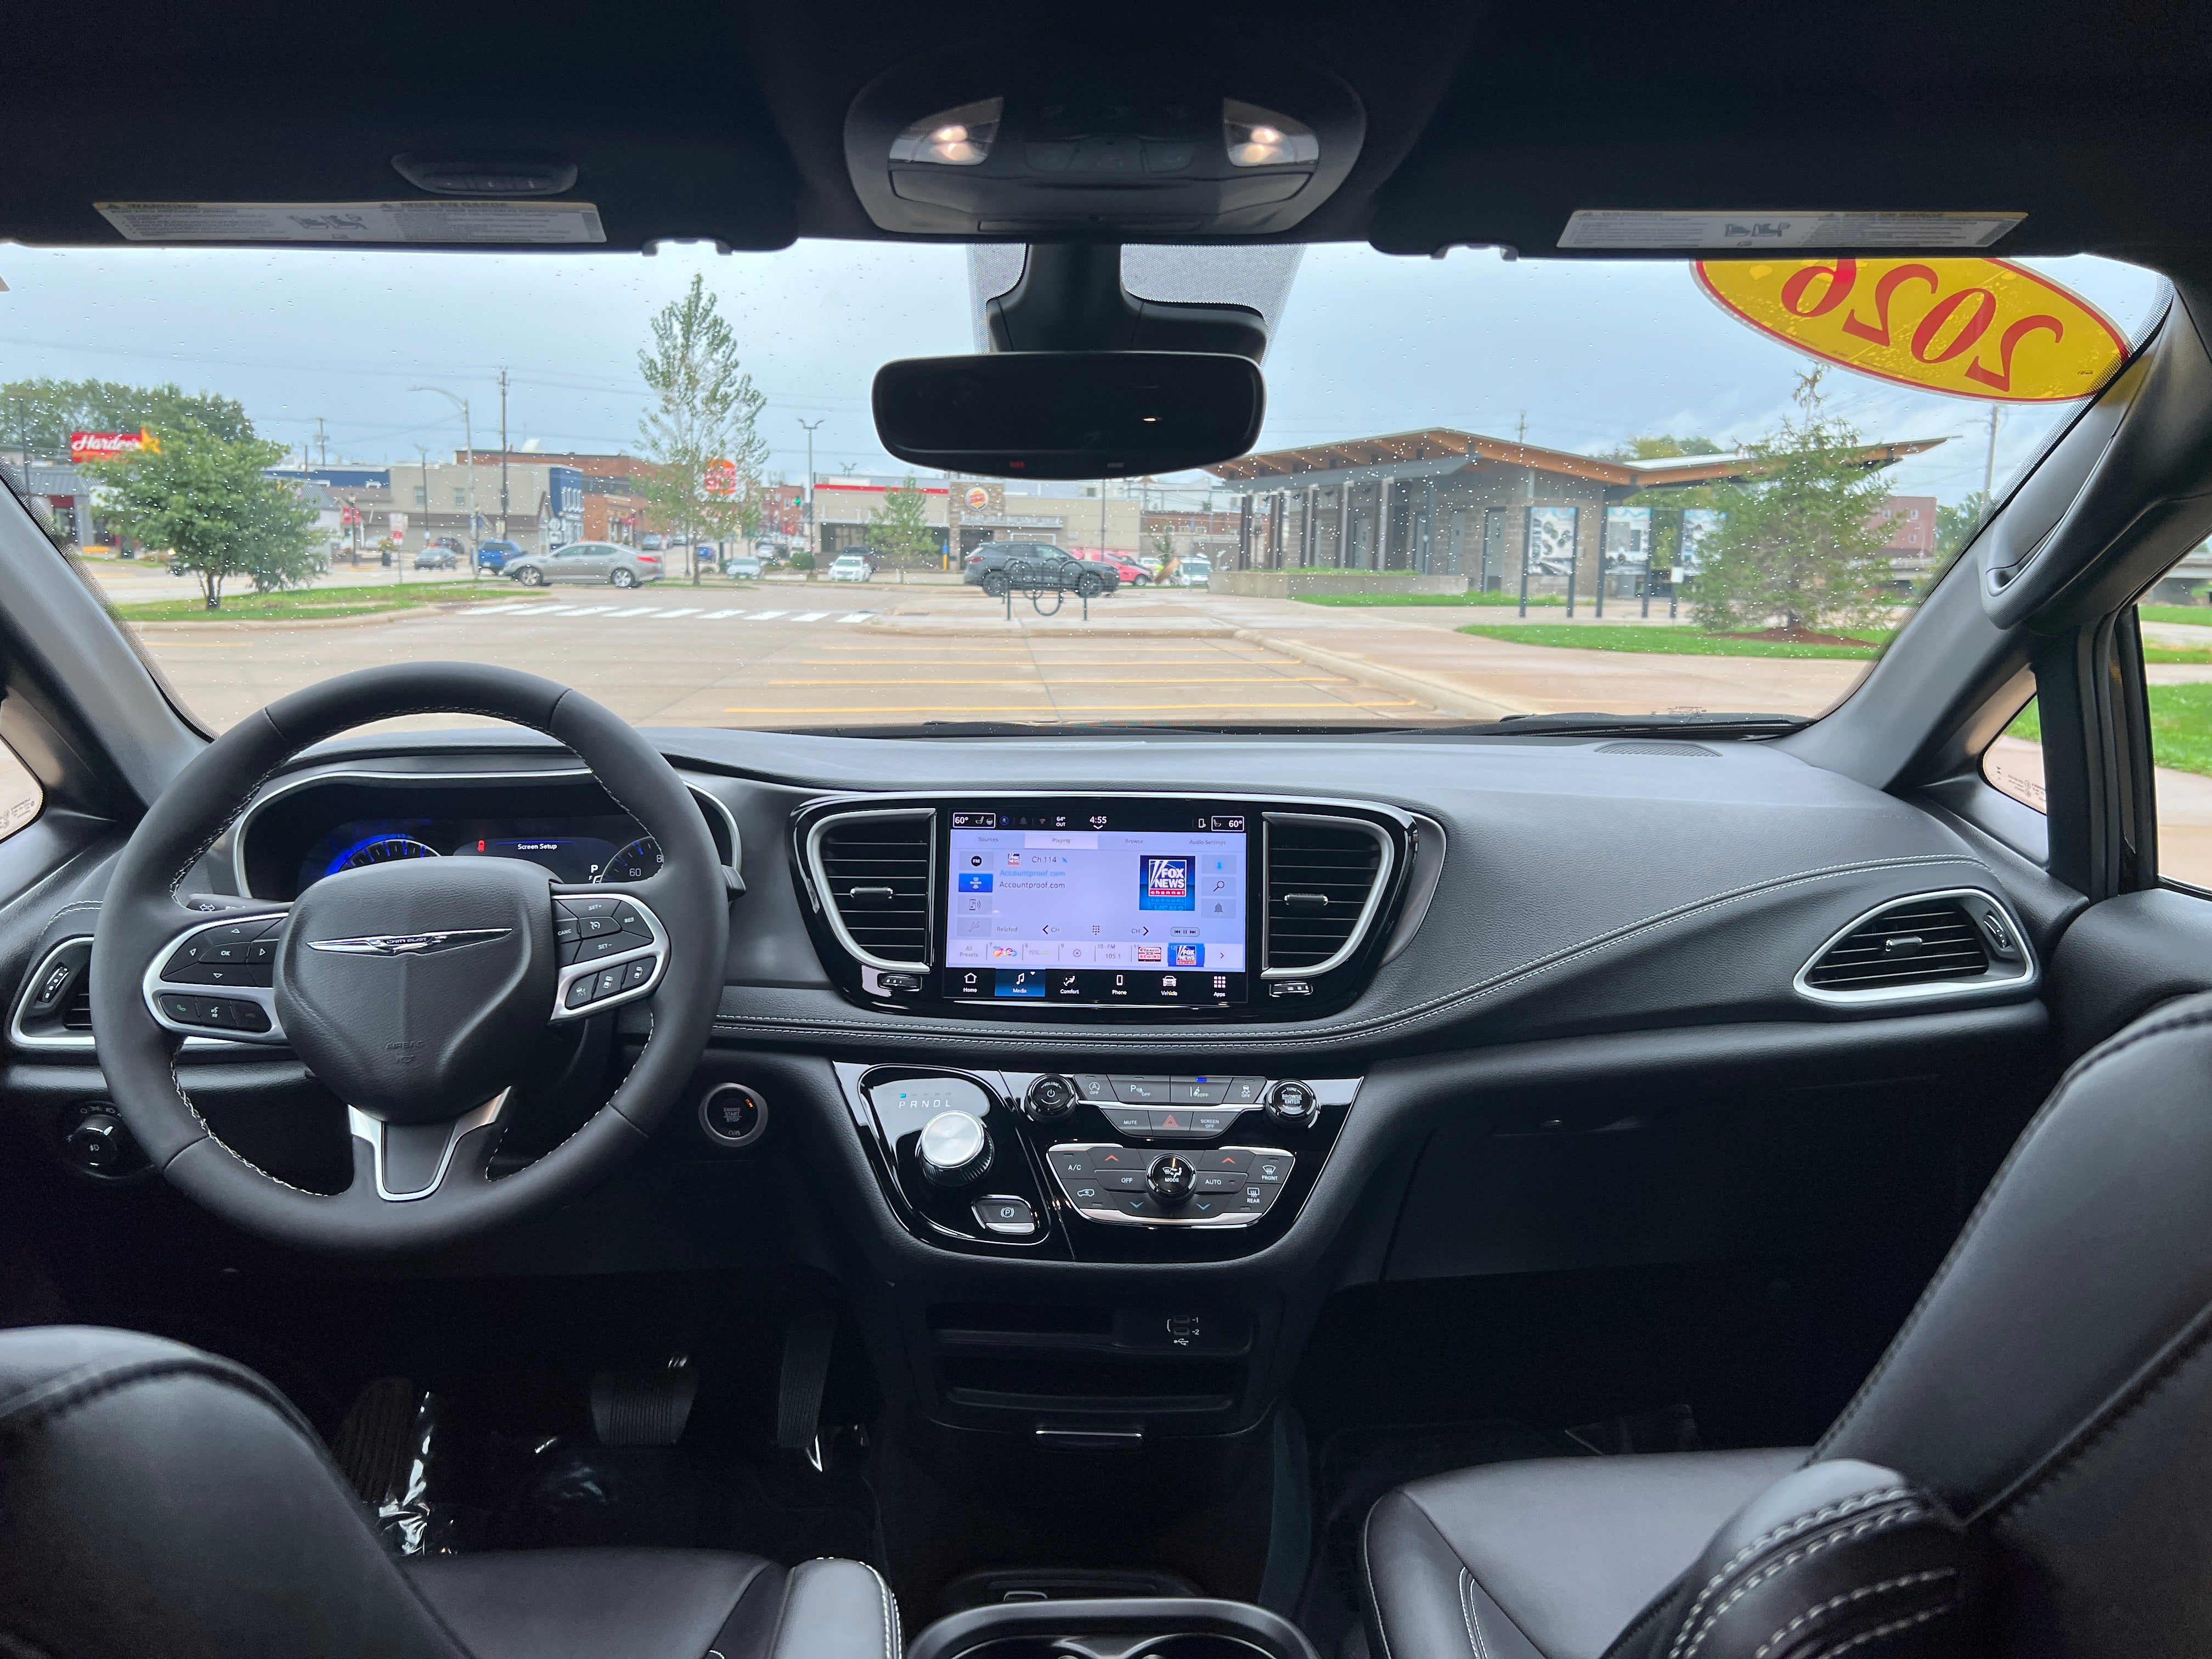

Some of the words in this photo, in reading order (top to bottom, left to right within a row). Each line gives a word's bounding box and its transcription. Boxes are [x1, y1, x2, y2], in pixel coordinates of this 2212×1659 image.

[591, 865, 599, 873] P
[629, 868, 641, 877] 60
[1161, 868, 1185, 878] FOX
[1000, 870, 1065, 878] Accountproof.com
[999, 882, 1065, 890] Accountproof.com
[1154, 878, 1185, 889] NEWS
[899, 1101, 906, 1109] P
[933, 1099, 941, 1108] D
[945, 1099, 951, 1107] L
